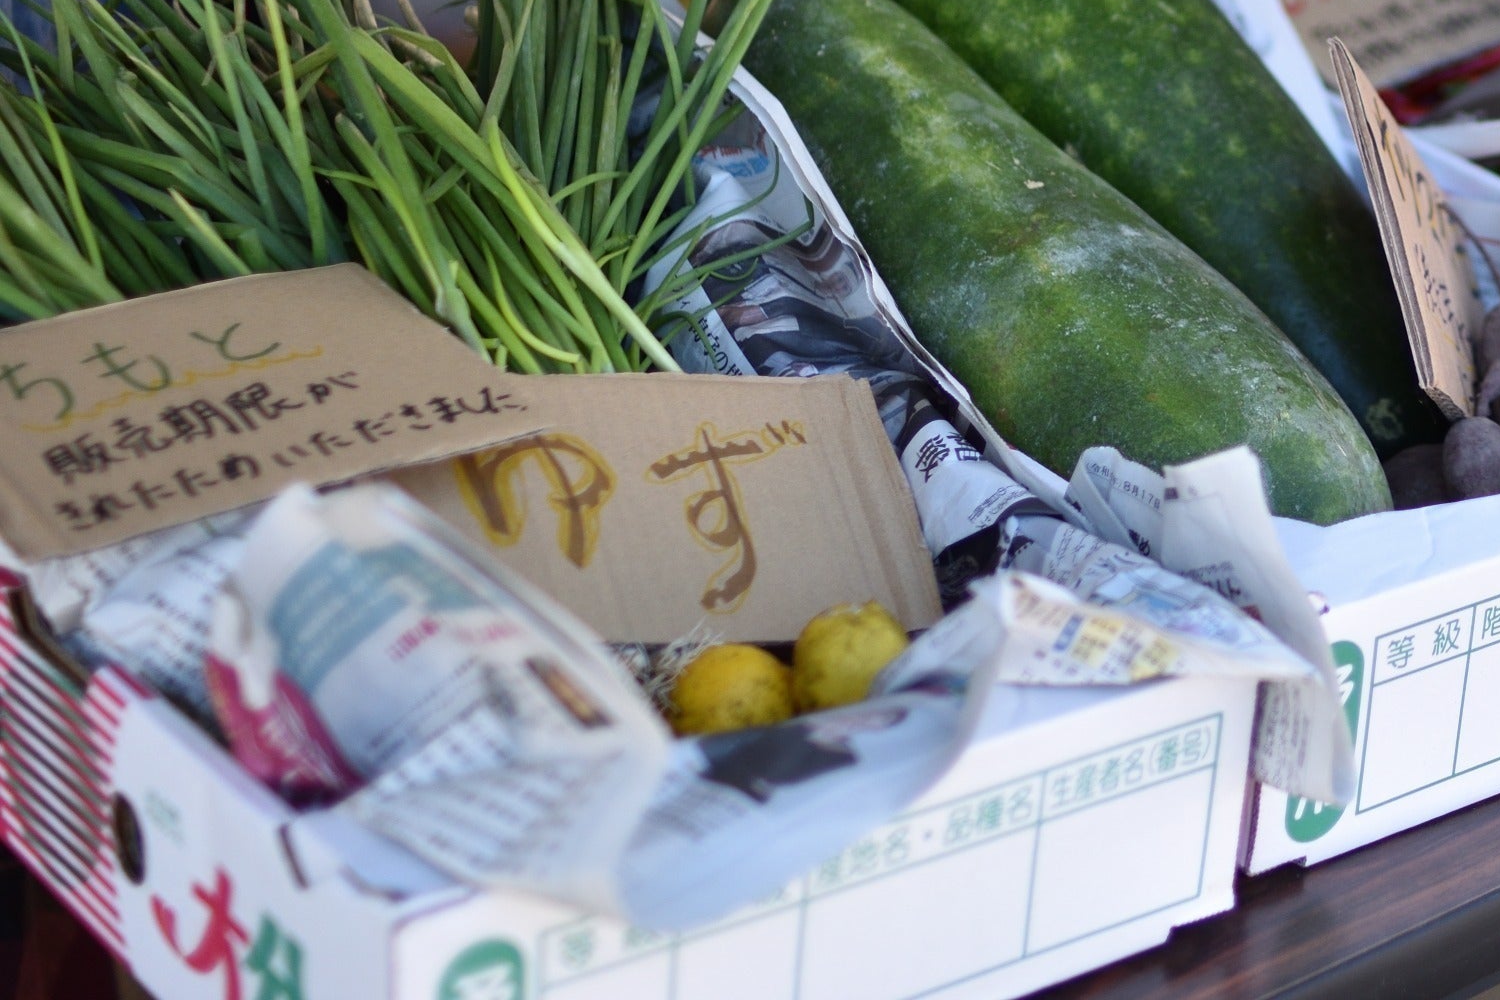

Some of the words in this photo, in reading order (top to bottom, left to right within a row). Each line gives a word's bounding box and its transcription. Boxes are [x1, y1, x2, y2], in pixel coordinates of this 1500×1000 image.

[0, 322, 282, 421] ちもと
[43, 370, 360, 486] 販売期限が
[448, 418, 808, 616] ゆず
